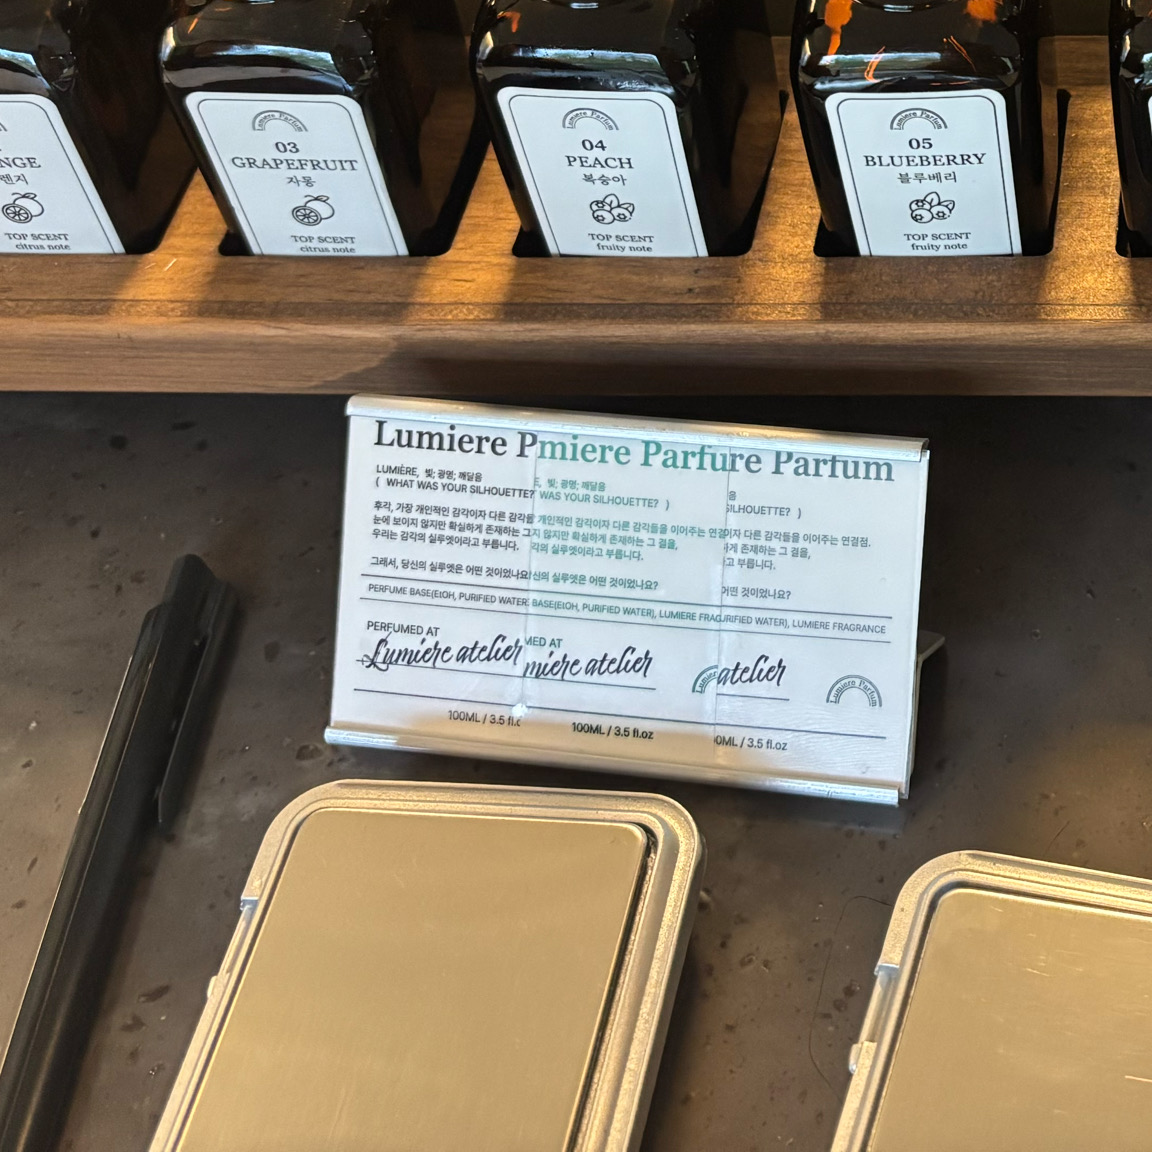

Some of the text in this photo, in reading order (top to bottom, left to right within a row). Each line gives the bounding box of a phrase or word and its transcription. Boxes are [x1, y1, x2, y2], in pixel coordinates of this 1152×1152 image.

[275, 142, 300, 154] 03
[582, 139, 607, 151] 04
[908, 138, 933, 149] 05
[232, 157, 358, 171] GRAPEFRUIT
[565, 155, 634, 169] PEACH
[863, 153, 986, 167] BLUEBERRY
[287, 176, 316, 187] 자몽
[583, 174, 627, 186] 복숭아
[897, 172, 957, 184] 블루베리
[291, 235, 355, 244] TOP SCENT
[588, 233, 654, 243] TOP SCENT
[597, 243, 626, 252] fruity
[911, 242, 940, 251] fruity
[374, 420, 508, 457] Lumiere
[377, 464, 419, 477] LUMIÈRE,
[772, 451, 895, 481] Parfum
[387, 478, 534, 499] WHAT WAS YOUR SILHOUETTE?
[564, 493, 659, 507] YOUR SILHOUETTE?
[416, 505, 486, 519] 개인적인 감각이자
[393, 516, 520, 537] 보이지 확실하게 존재하는
[671, 526, 705, 538] 이어주는
[372, 529, 426, 542] 우리는 감각의
[803, 534, 839, 544] 이어주는
[401, 559, 463, 574] 당신의 실루엣은
[368, 584, 496, 603] PERFUME PURIFIED
[741, 587, 791, 599] 것이었나요?
[583, 604, 696, 620] PURIFIED LUMIERE
[367, 621, 440, 636] PERFUMED AT
[755, 617, 886, 634] WATER), LUMIERE FRAGRANCE
[456, 634, 522, 666] atelier
[585, 646, 653, 678] atelier
[717, 654, 786, 686] atelier
[449, 710, 480, 722] 100ML
[572, 722, 654, 739] 100ML 3.5 fl.oz
[747, 738, 787, 750] 3.5 fl.oz
